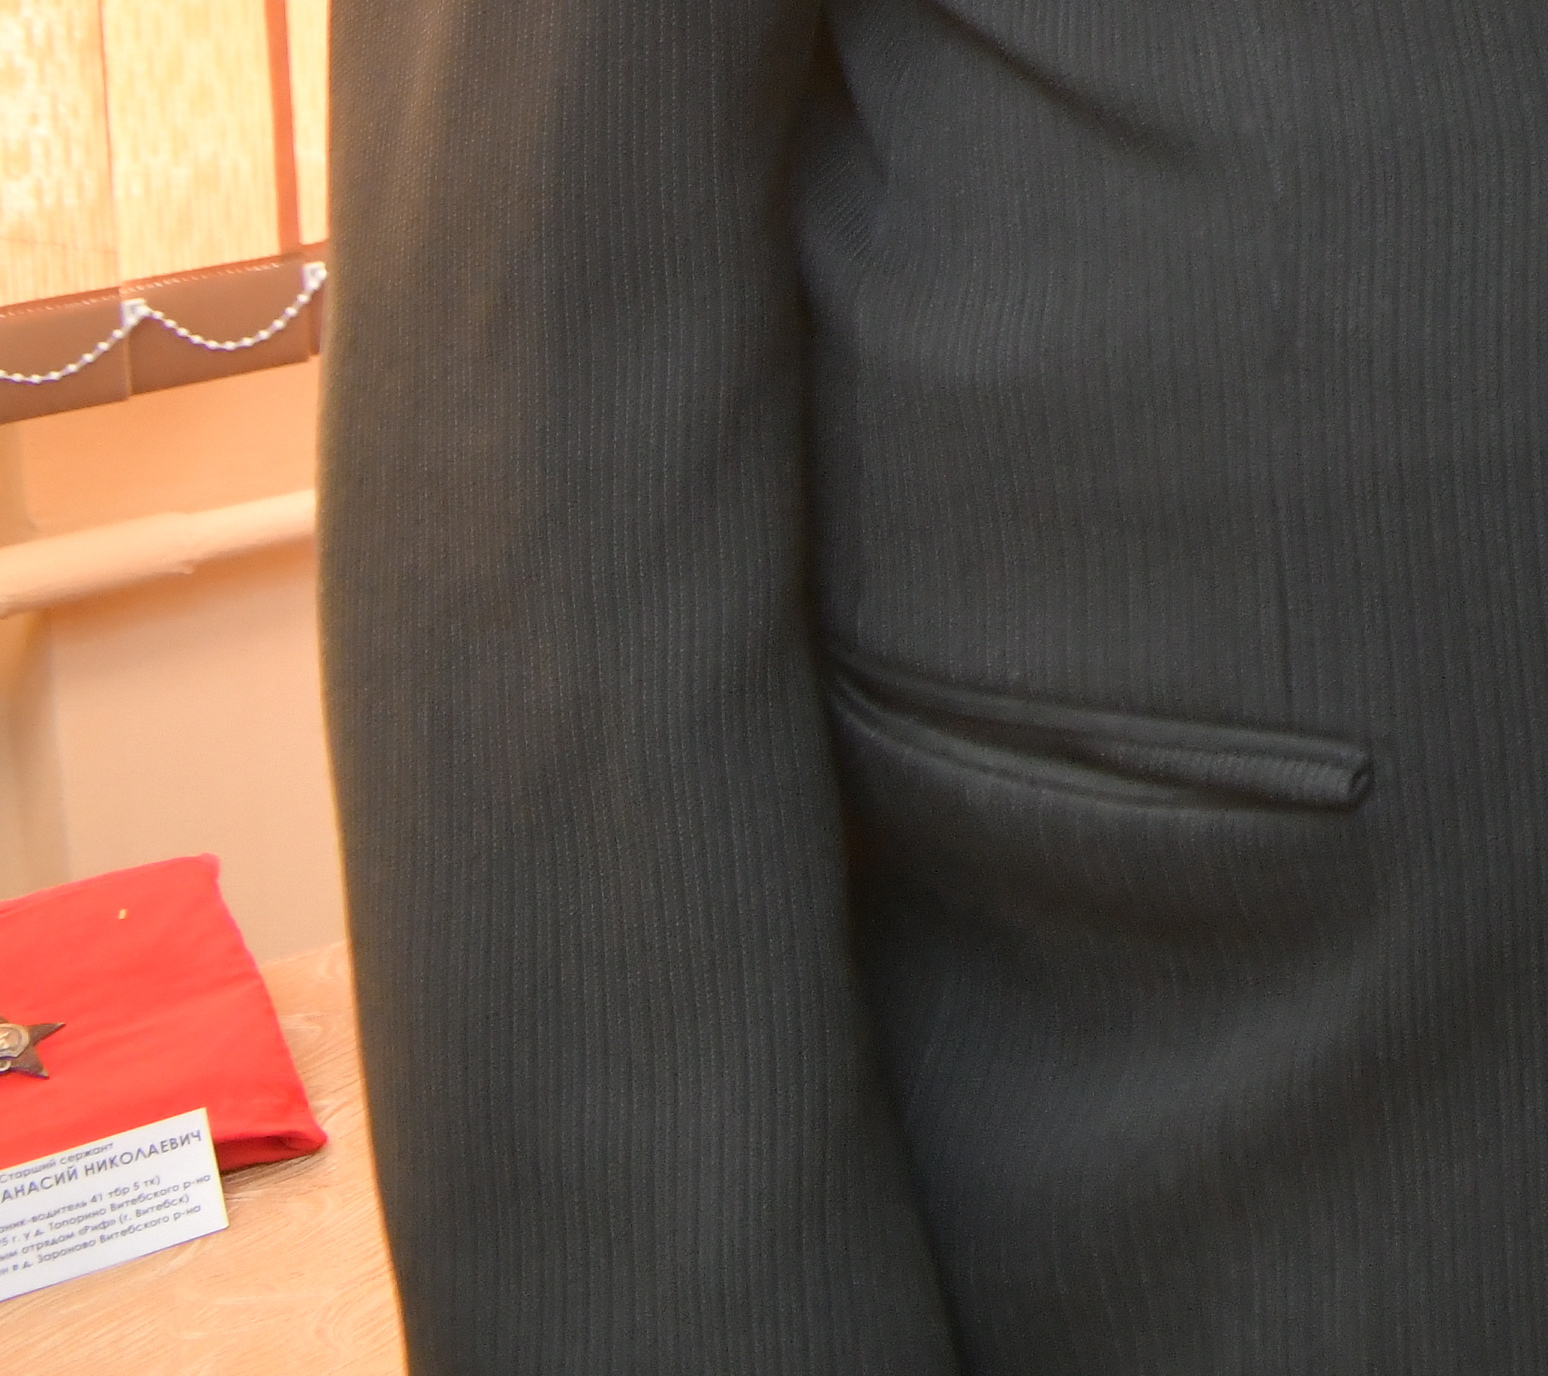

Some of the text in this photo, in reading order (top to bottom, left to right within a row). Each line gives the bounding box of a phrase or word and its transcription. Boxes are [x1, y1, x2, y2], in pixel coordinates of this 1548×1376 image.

[0, 1142, 114, 1184] Старший сержант
[1, 1129, 203, 1203] АНАСИЙ НИКОЛАЕВИЧ
[133, 1181, 141, 1192] 5
[21, 1231, 75, 1254] отрядом
[135, 1193, 190, 1219] Витебск)
[48, 1207, 107, 1231] Топорино
[110, 1183, 180, 1213] Витебского
[183, 1174, 211, 1190] р-на
[37, 1239, 97, 1264] Зароново
[99, 1214, 170, 1245] Витебского
[173, 1204, 202, 1221] р-на
